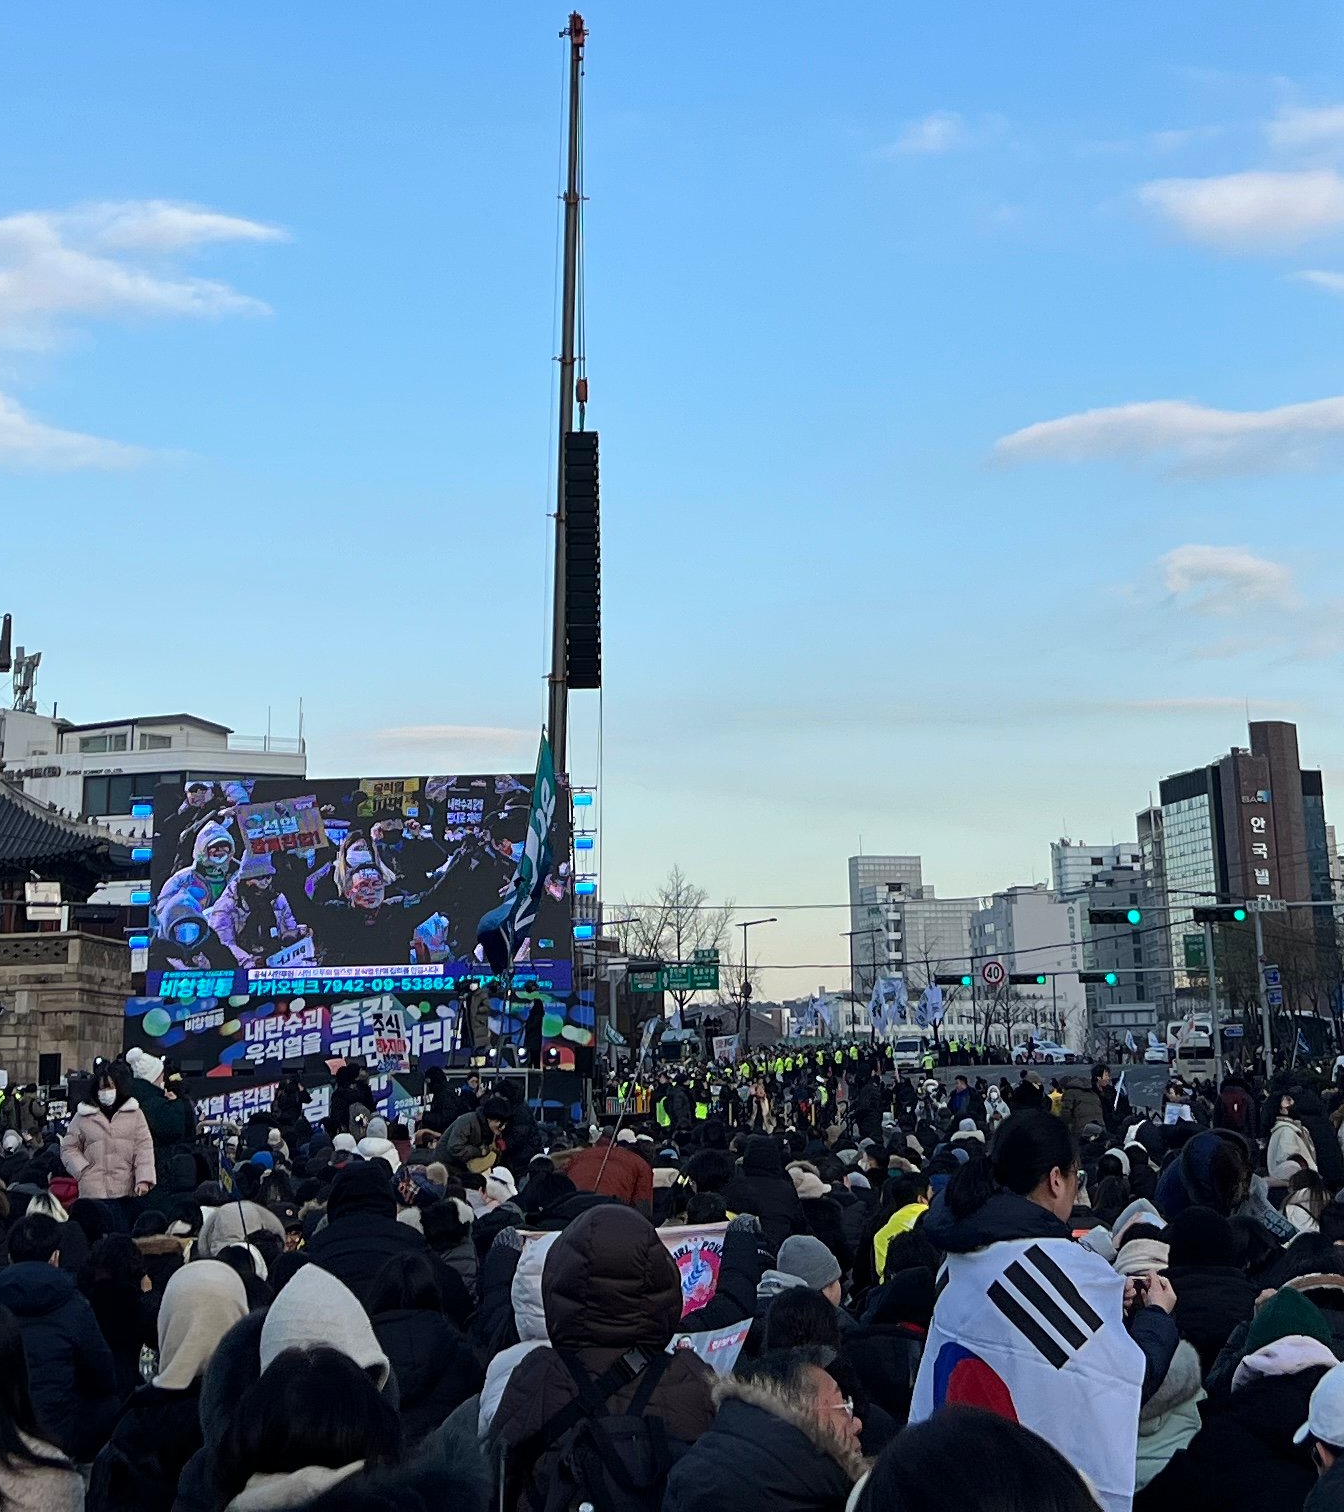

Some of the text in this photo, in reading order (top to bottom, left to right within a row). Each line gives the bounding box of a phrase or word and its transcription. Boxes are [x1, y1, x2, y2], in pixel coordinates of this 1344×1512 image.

[248, 979, 319, 996] 카카오뱅크
[323, 976, 455, 992] 7942-09-53862
[986, 967, 999, 979] 40
[244, 1007, 323, 1042] 내란수괴
[373, 1013, 401, 1039] 주식
[245, 1031, 323, 1065] 윤석열을
